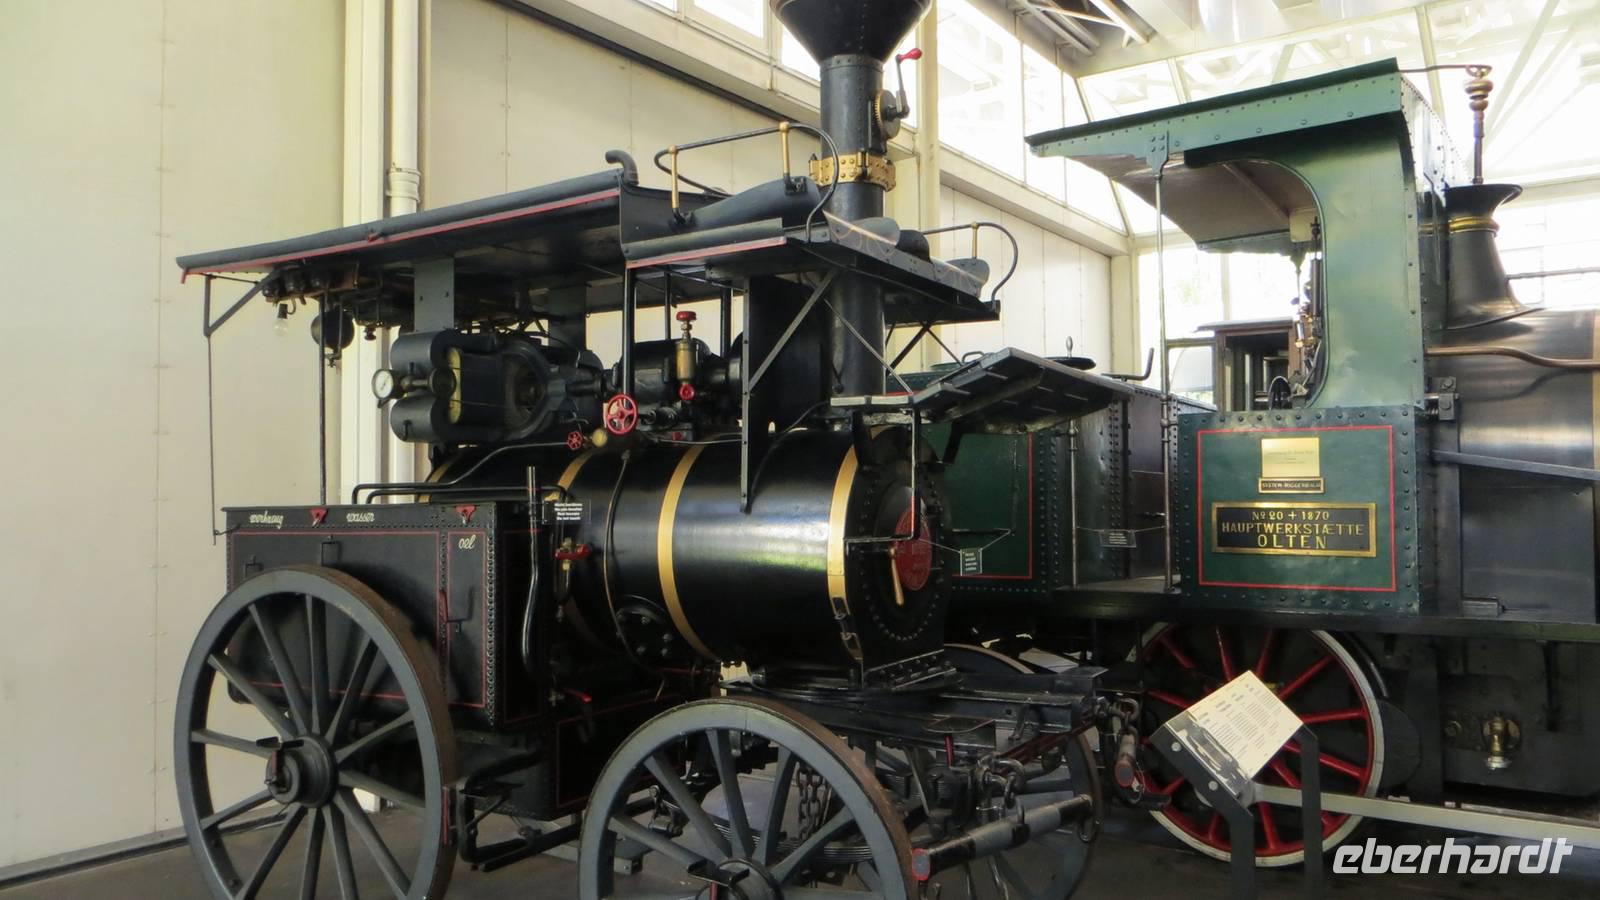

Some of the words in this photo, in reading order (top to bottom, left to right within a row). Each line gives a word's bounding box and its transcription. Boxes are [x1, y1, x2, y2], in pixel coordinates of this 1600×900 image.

[1269, 511, 1284, 521] 20
[1301, 511, 1330, 521] 1870
[1257, 534, 1327, 549] OLTEN
